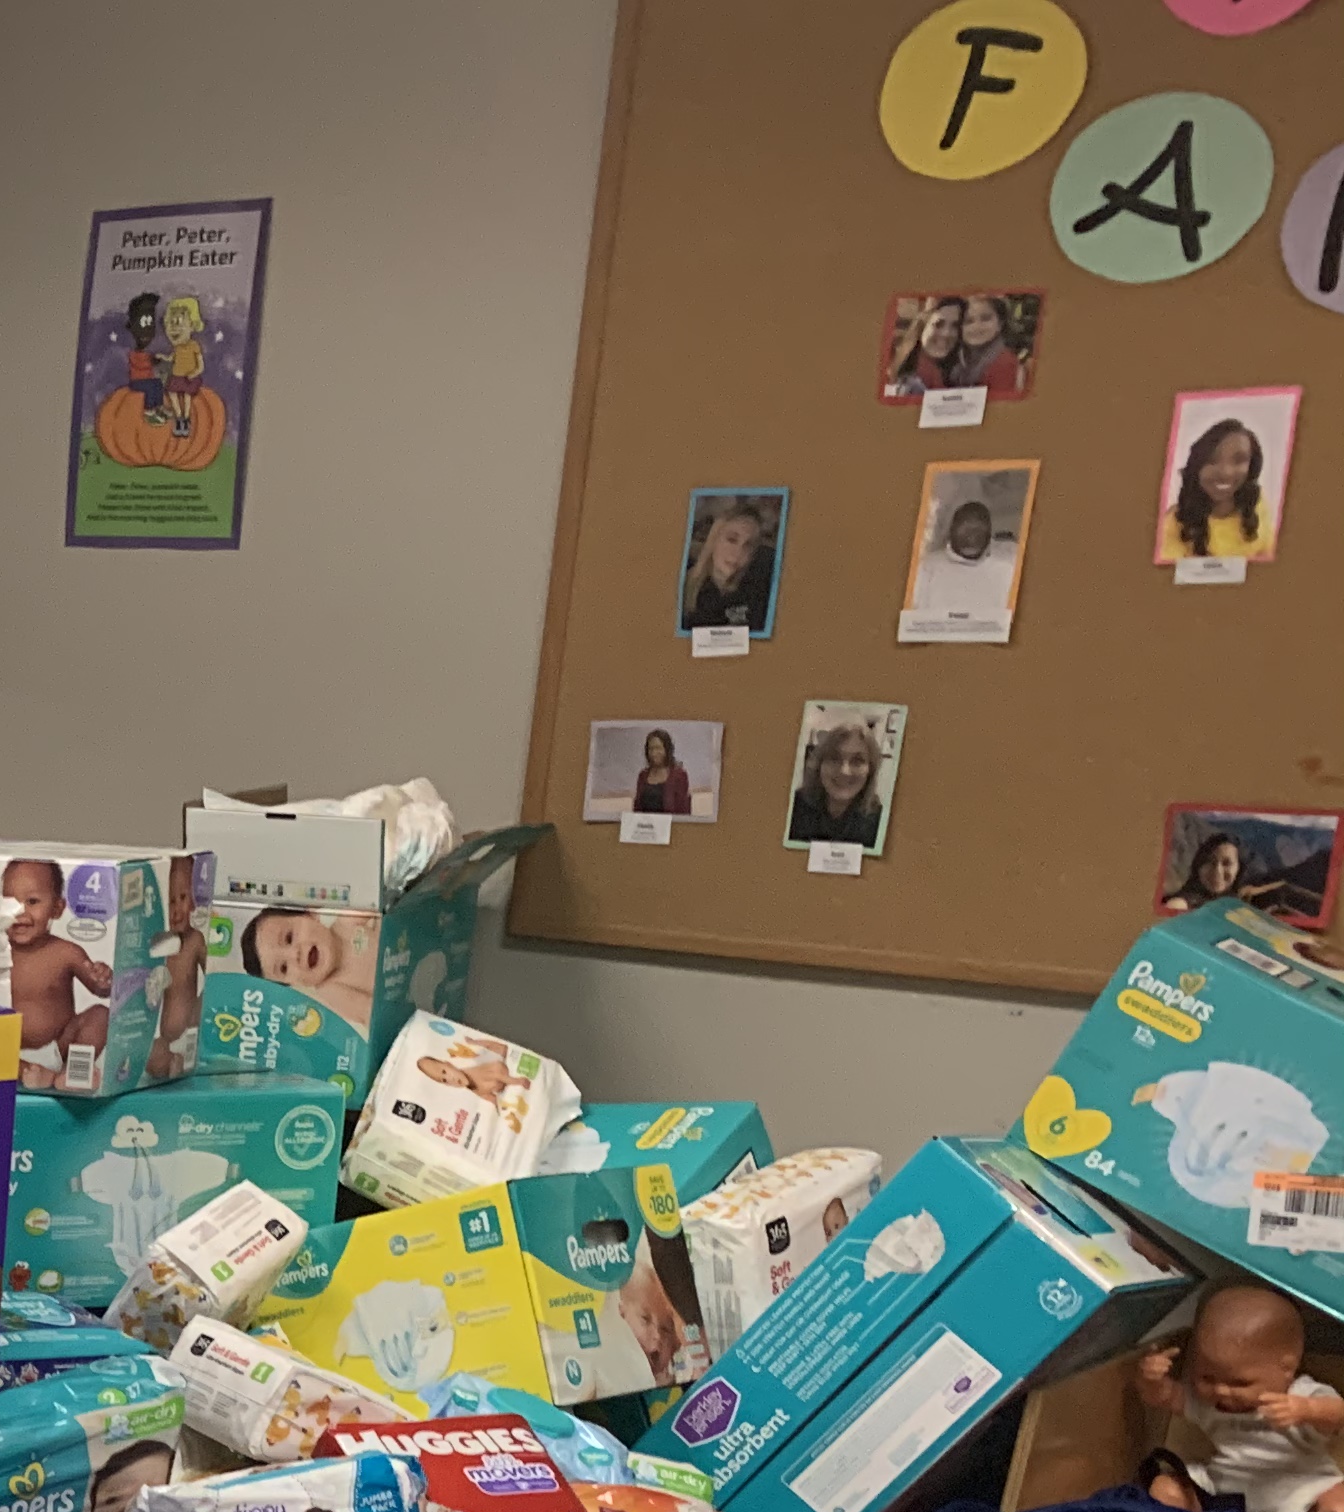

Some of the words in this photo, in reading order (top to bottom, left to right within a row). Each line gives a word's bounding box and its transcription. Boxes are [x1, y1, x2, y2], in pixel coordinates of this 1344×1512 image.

[938, 26, 1044, 150] F
[1071, 120, 1211, 261] A
[121, 230, 170, 248] Peter,
[176, 227, 231, 244] Peter,
[111, 251, 184, 273] Pumpkin
[188, 249, 237, 267] Eater
[85, 872, 102, 892] 4
[1128, 960, 1215, 1023] Pampers
[1049, 1115, 1069, 1135] 6
[1084, 1151, 1116, 1177] 84
[468, 1211, 491, 1234] #1
[566, 1235, 631, 1272] Pampers
[770, 1260, 792, 1280] Soft
[548, 1292, 594, 1309] swaddlers
[579, 1312, 592, 1330] #1
[335, 1426, 546, 1458] HUGGIES
[711, 1407, 790, 1492] absorbent
[713, 1420, 756, 1462] ultra
[467, 1462, 551, 1483] movers
